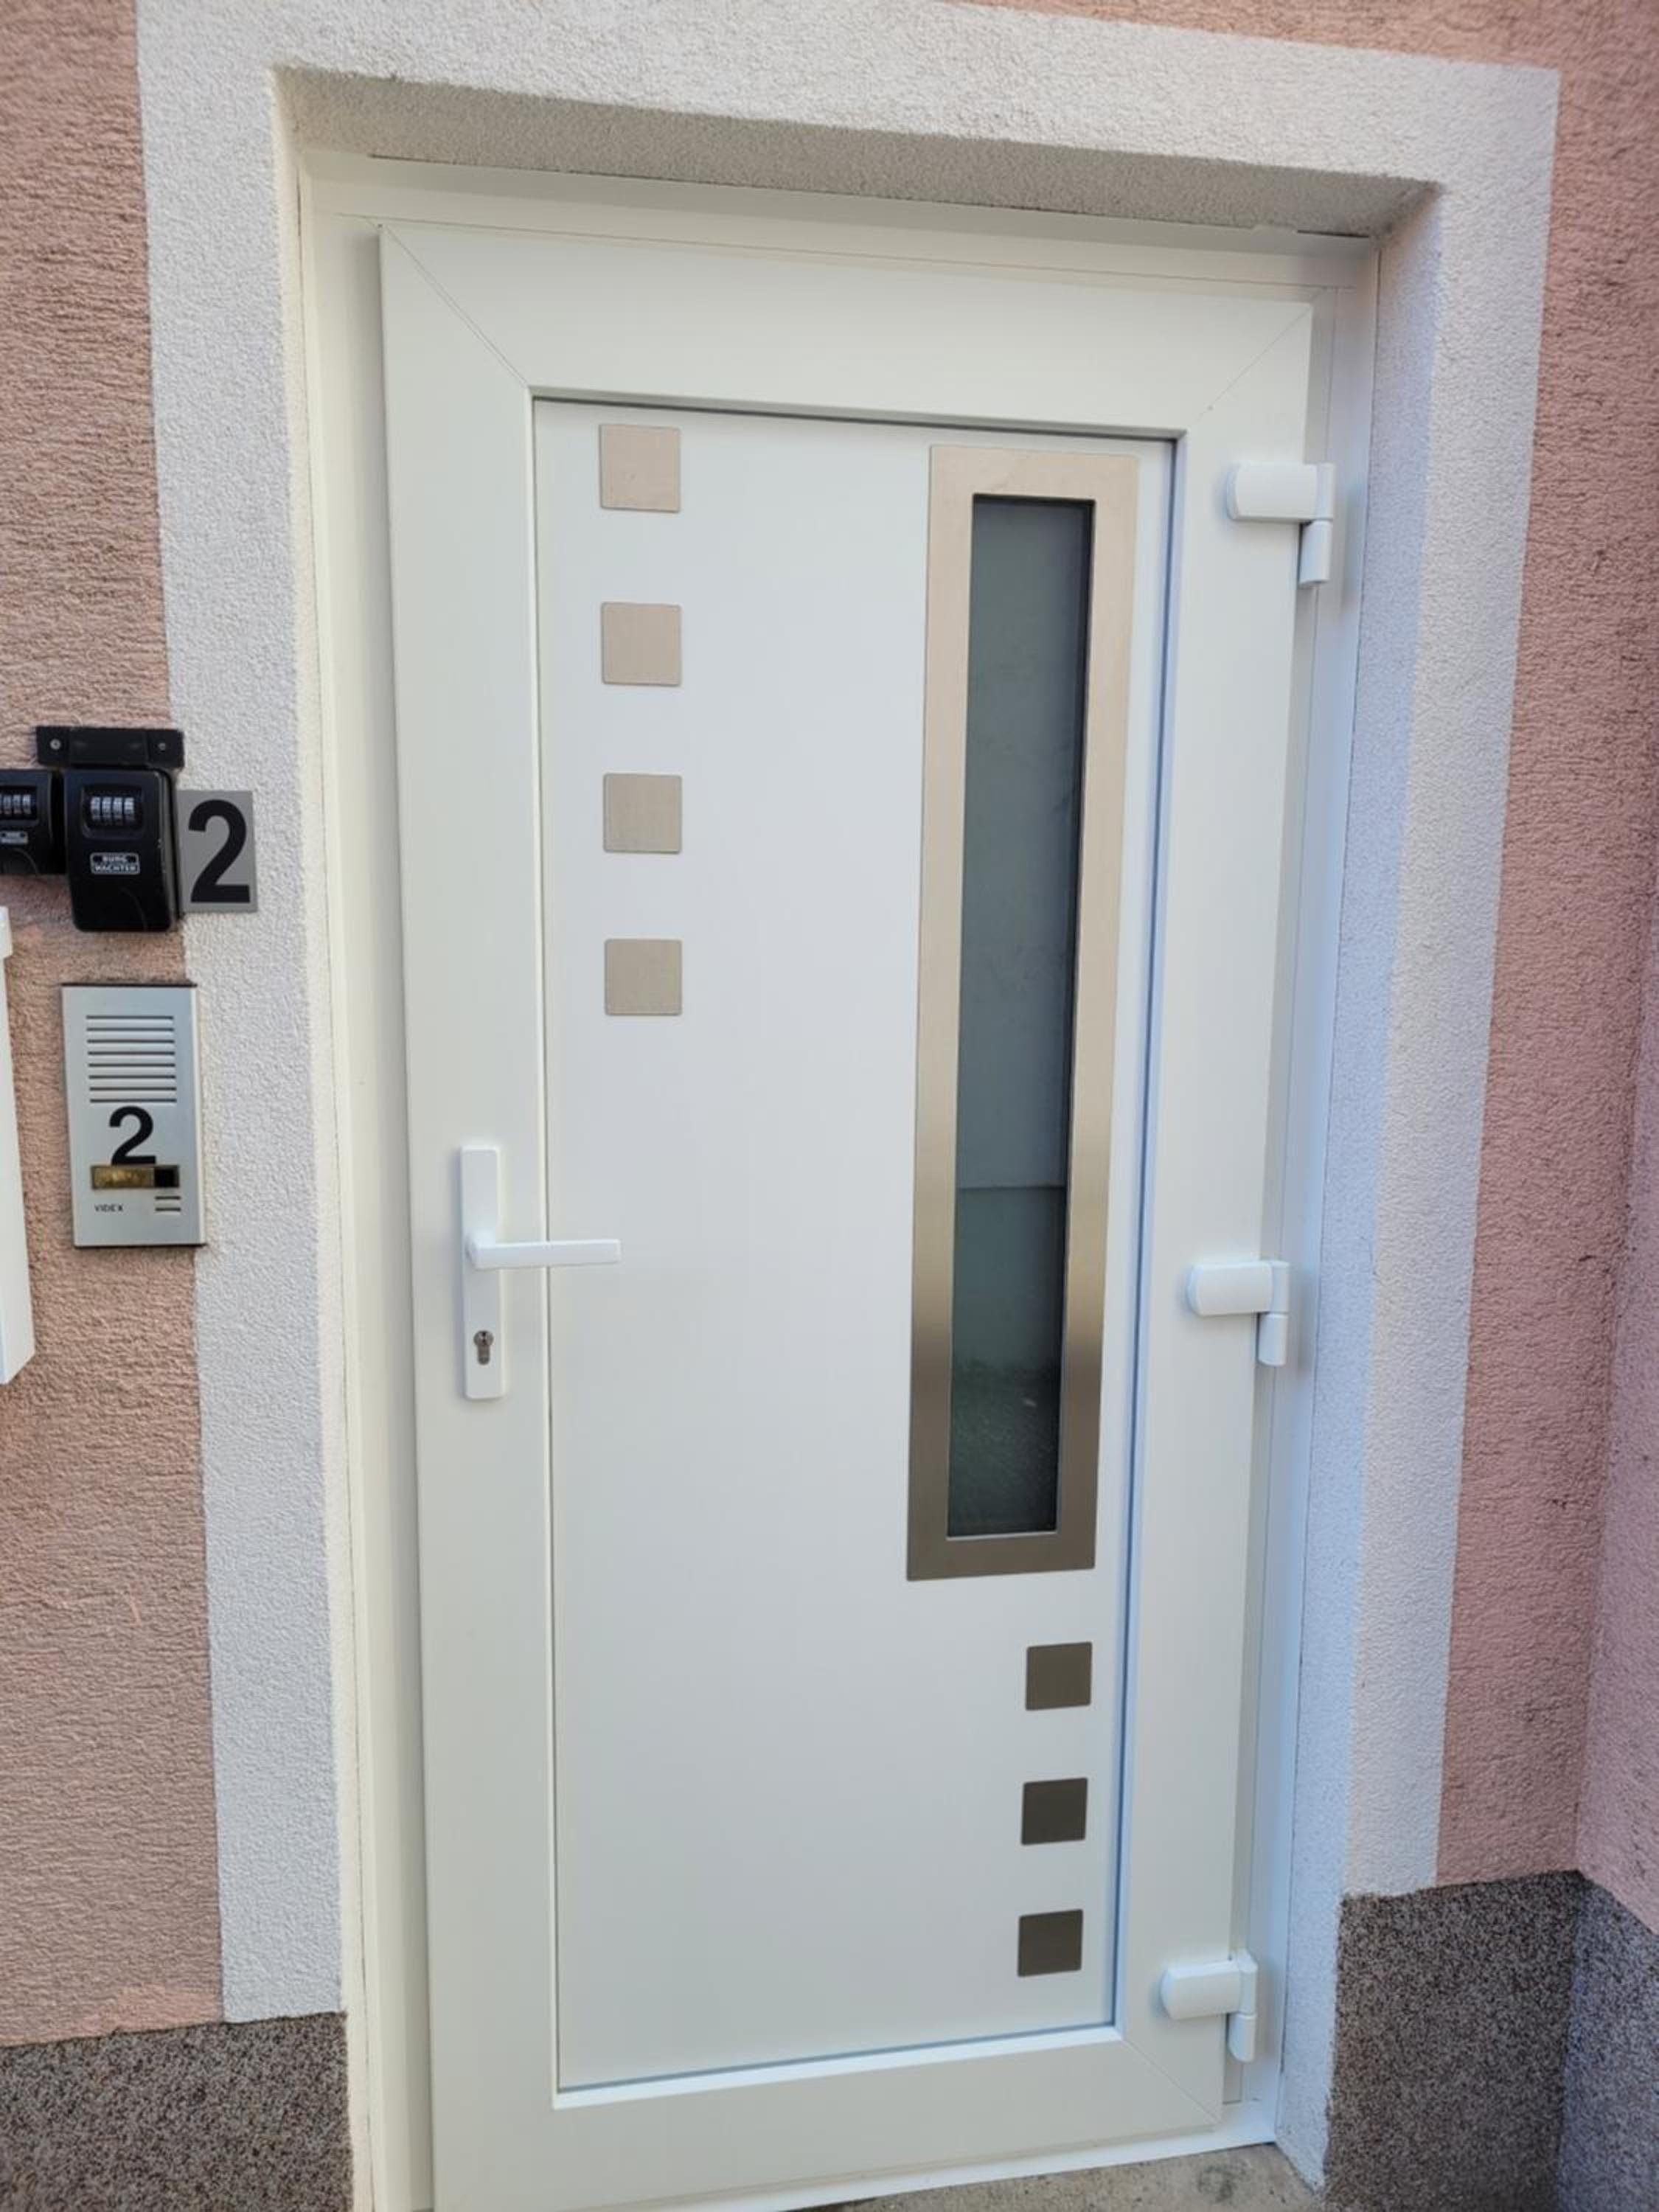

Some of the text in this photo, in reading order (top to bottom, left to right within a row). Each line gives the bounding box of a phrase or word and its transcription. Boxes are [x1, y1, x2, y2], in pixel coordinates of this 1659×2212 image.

[188, 799, 251, 903] 2
[108, 1106, 156, 1166] 2
[94, 1203, 123, 1212] VIDEX
